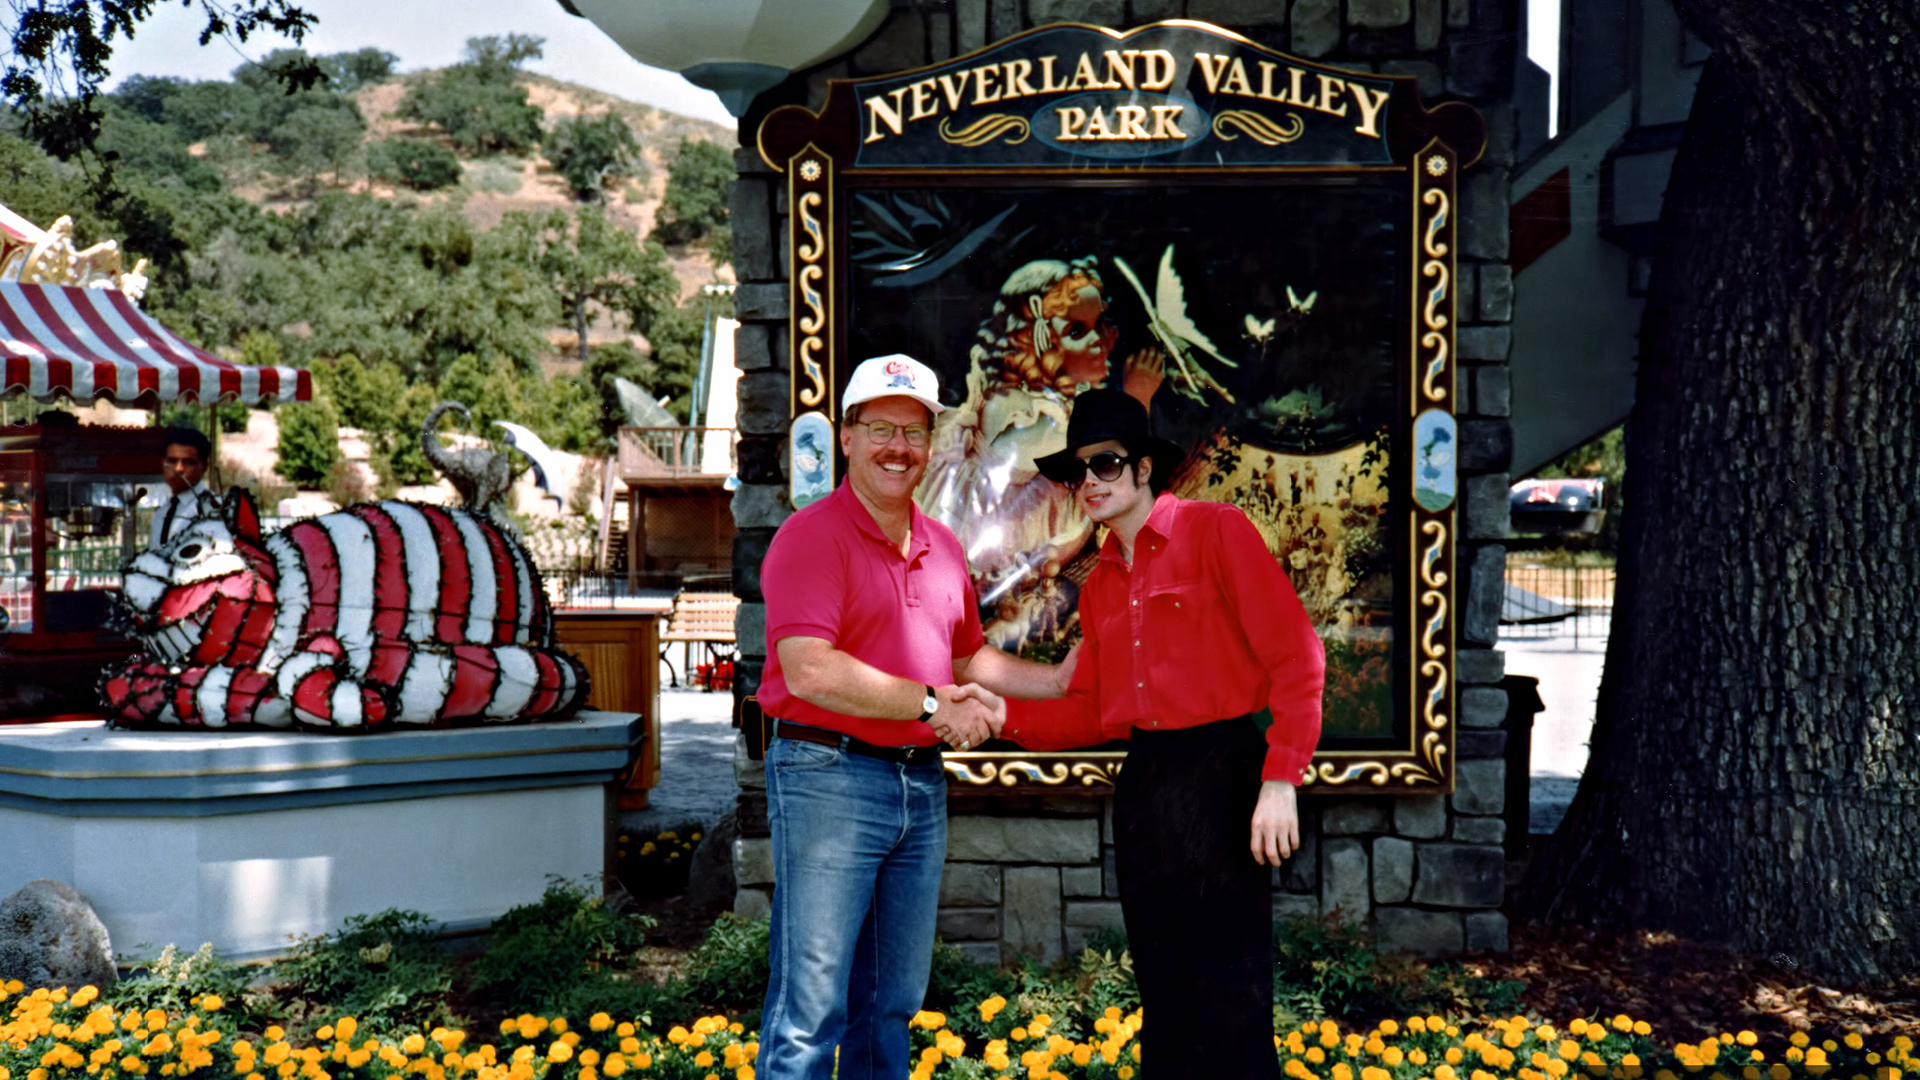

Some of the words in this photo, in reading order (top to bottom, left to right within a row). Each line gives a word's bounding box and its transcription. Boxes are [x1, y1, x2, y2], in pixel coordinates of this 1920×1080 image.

[863, 49, 1178, 144] NEVERLAND
[1193, 52, 1390, 138] VALLEY
[1055, 105, 1187, 141] PARK
